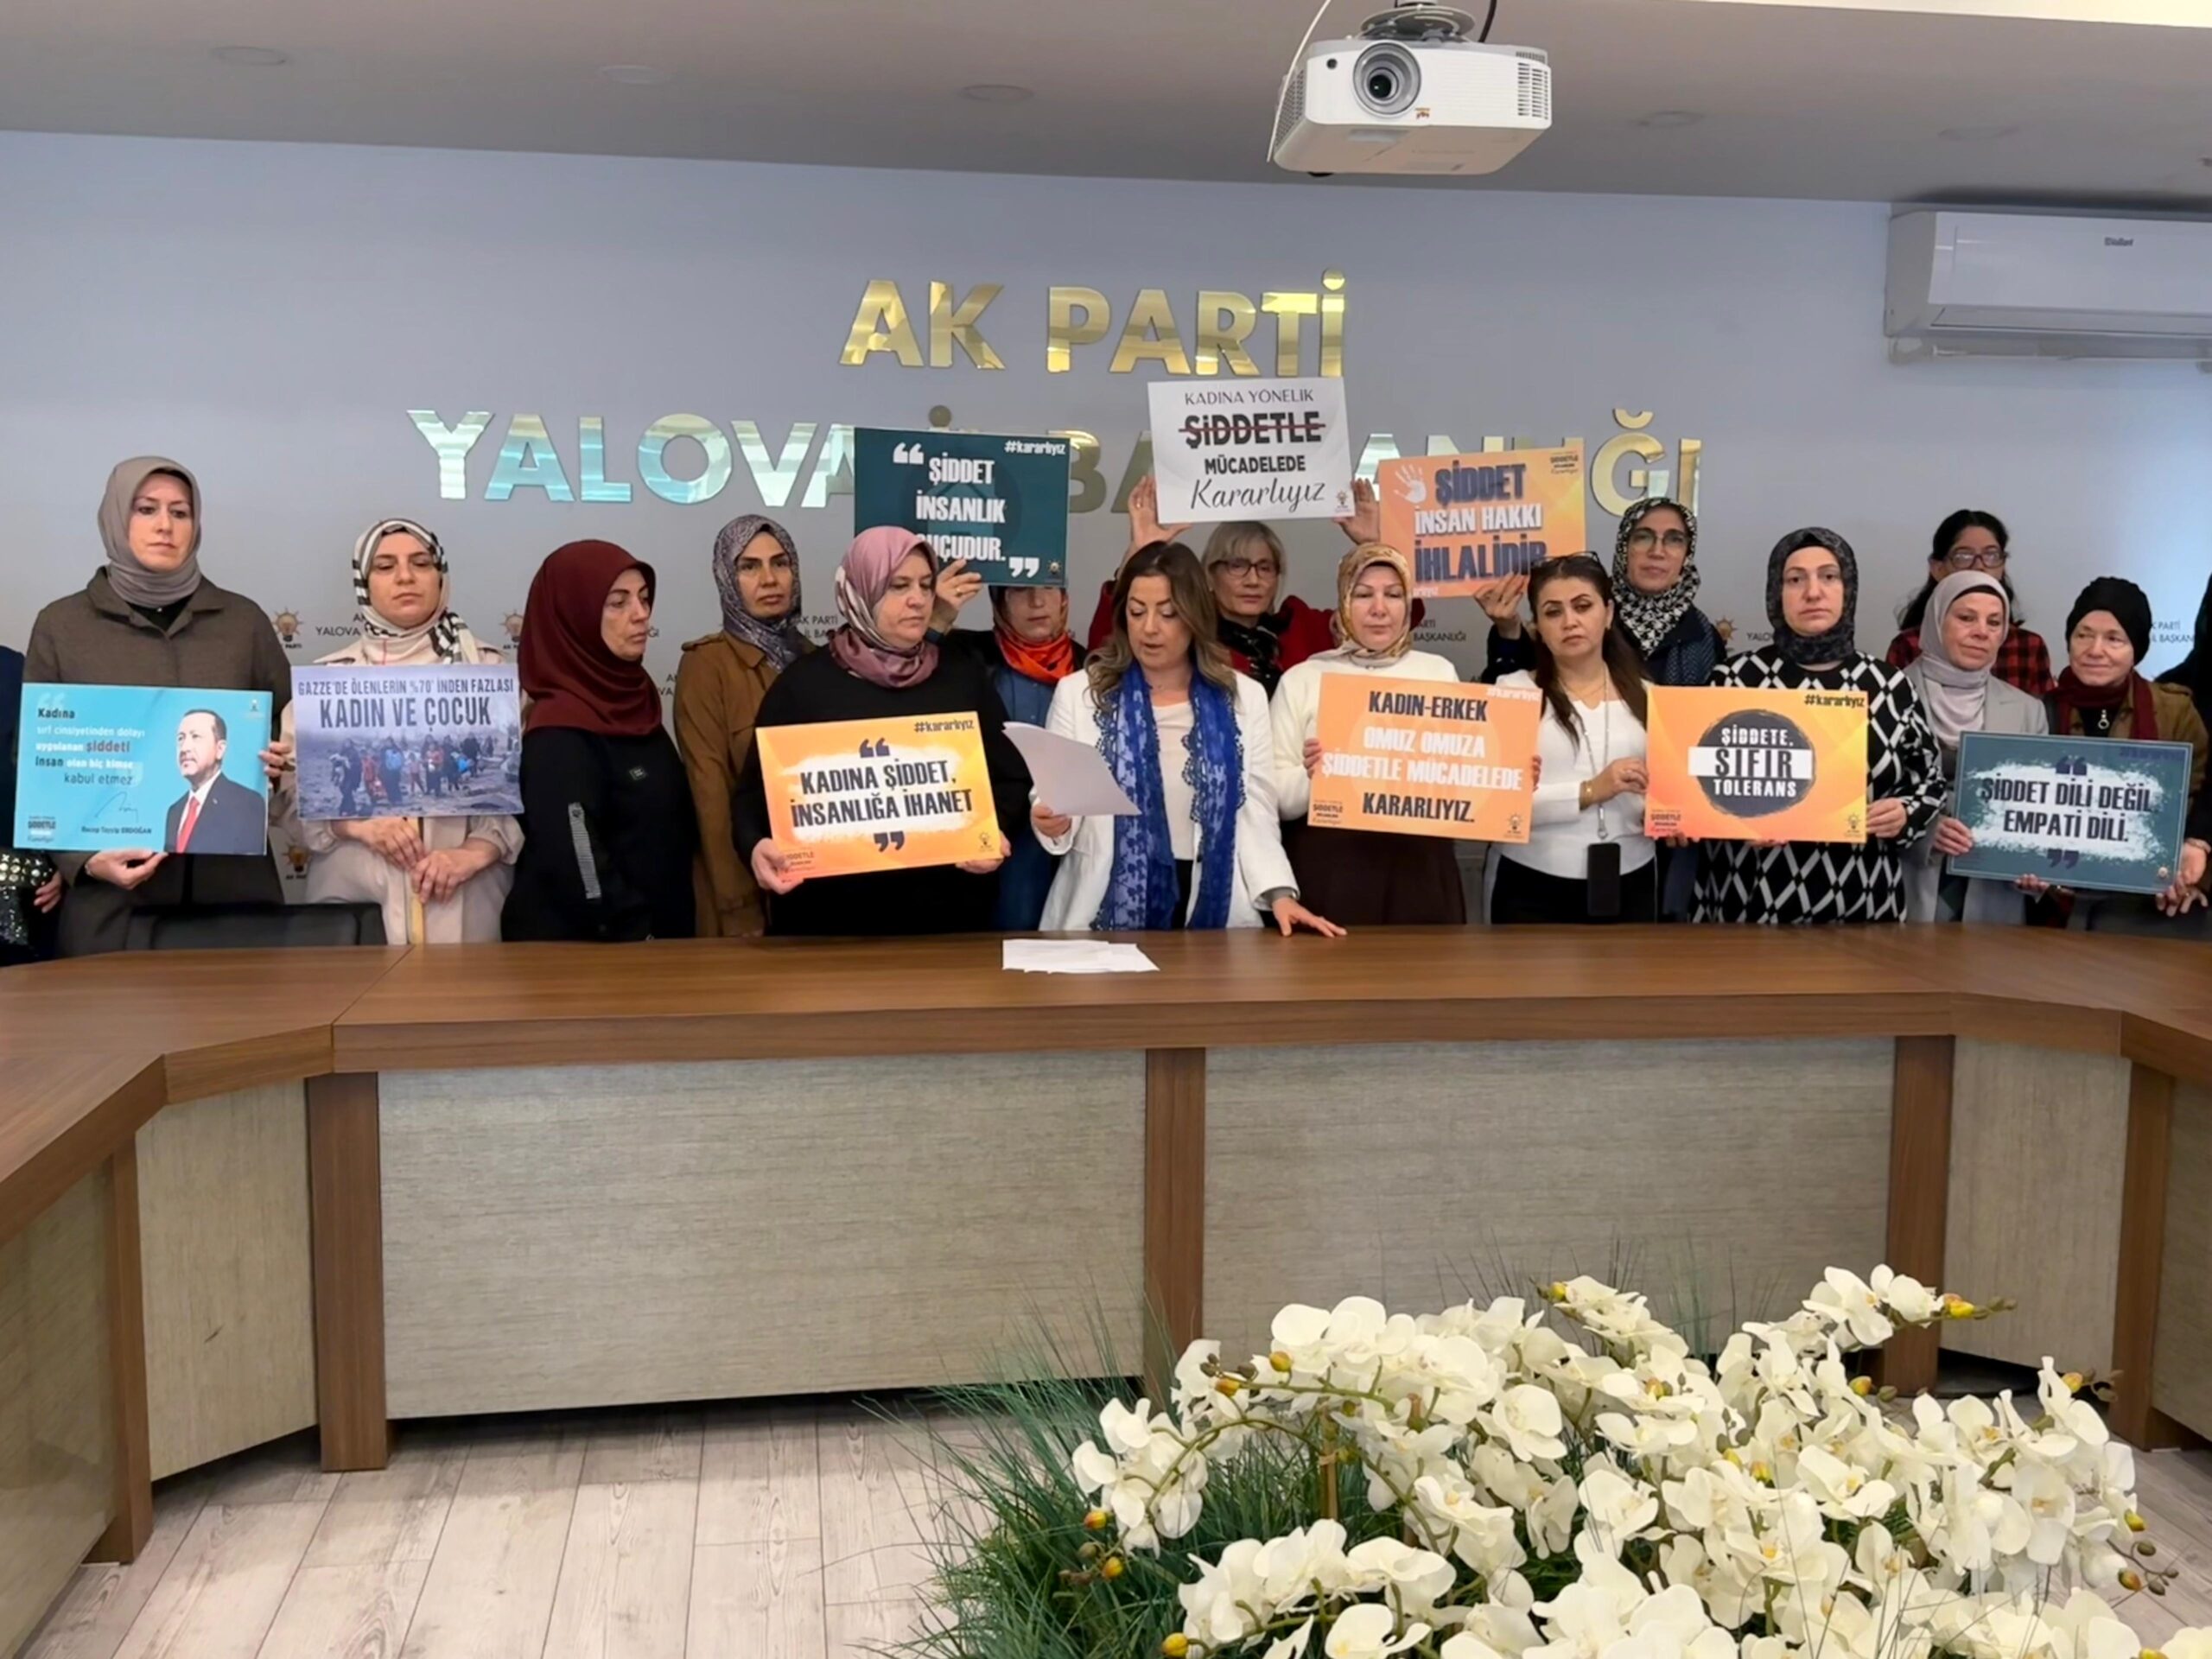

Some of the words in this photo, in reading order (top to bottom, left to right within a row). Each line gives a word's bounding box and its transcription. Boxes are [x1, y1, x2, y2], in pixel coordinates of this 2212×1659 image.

[838, 279, 1006, 371] AK
[1046, 268, 1345, 377] PARTİ
[1185, 391, 1244, 405] KADINA
[929, 452, 995, 485] ŞİDDET
[1205, 454, 1306, 474] MÜCADELEDE
[1191, 477, 1325, 512] Kararlıyız
[1435, 460, 1526, 508] ŞİDDET
[916, 490, 1005, 523] İNSANLIK
[1414, 505, 1476, 535] İNSAN
[1481, 503, 1542, 531] HAKKI
[315, 626, 361, 637] YALOVA
[298, 681, 348, 696] GAZZE'DE
[352, 677, 406, 695] ÖLENLERİN
[437, 677, 467, 693] İNDEN
[471, 677, 514, 693] FAZLASI
[37, 708, 75, 719] Kadına
[320, 698, 385, 728] KADIN
[392, 697, 417, 727] VE
[424, 696, 491, 732] ÇOCUK
[1369, 690, 1488, 721] KADIN-ERKEK
[1363, 726, 1415, 753] OMUZ
[1421, 730, 1485, 758] OMUZA
[64, 772, 94, 785] kabul
[800, 766, 879, 795] KADINA
[884, 759, 957, 791] ŞİDDET,
[1322, 747, 1402, 781] ŞİDDETLE
[1407, 756, 1522, 791] MÜCADELEDE
[1715, 748, 1792, 779] SIFIR
[1713, 779, 1796, 798] TOLERANS
[1981, 772, 2050, 804] ŞİDDET
[2055, 778, 2093, 806] DİLİ
[791, 792, 899, 827] İNSANLIĞA
[903, 788, 972, 817] İHANET
[1363, 792, 1475, 823] KARARLIYIZ.
[2003, 810, 2082, 838] EMPATİ
[2087, 811, 2128, 842] DİLİ.
